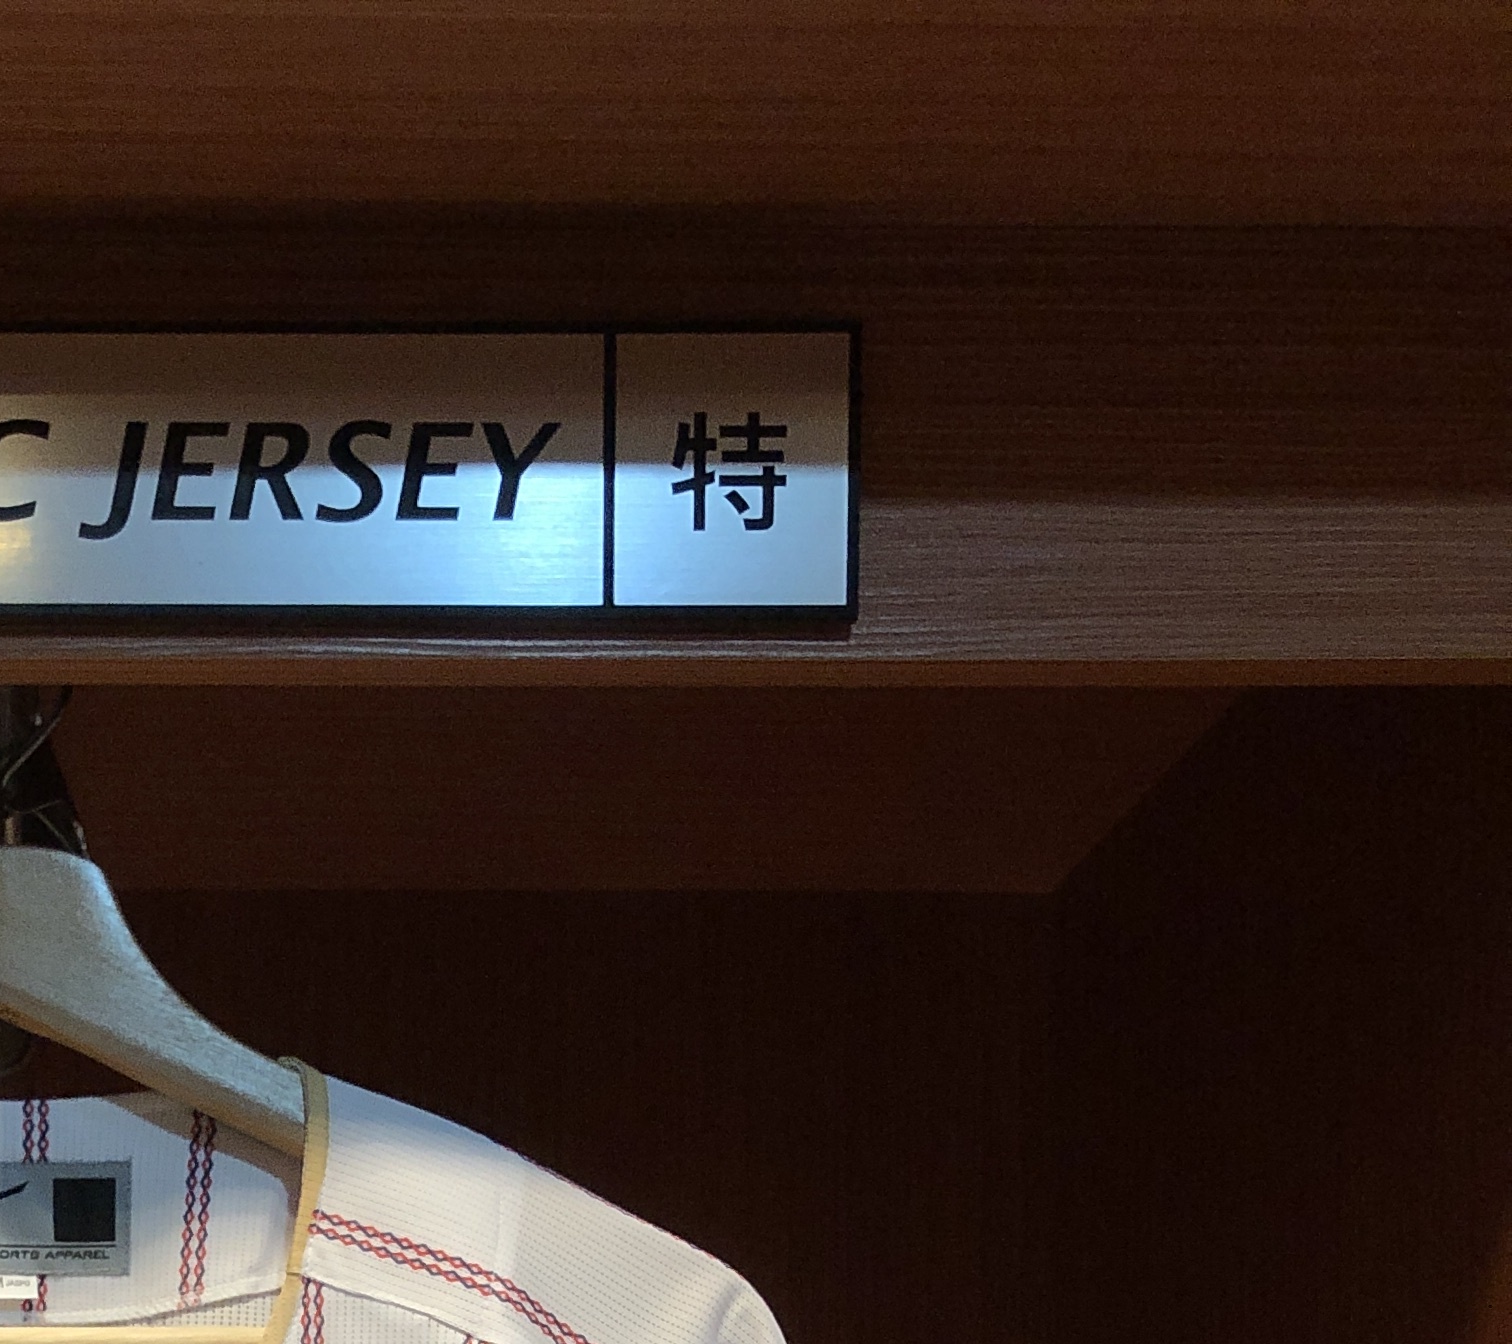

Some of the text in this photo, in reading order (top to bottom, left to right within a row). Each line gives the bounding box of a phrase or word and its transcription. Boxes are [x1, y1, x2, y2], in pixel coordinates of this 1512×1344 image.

[79, 419, 562, 541] JERSEY
[671, 411, 789, 531] 特
[44, 1249, 110, 1260] APPAREL
